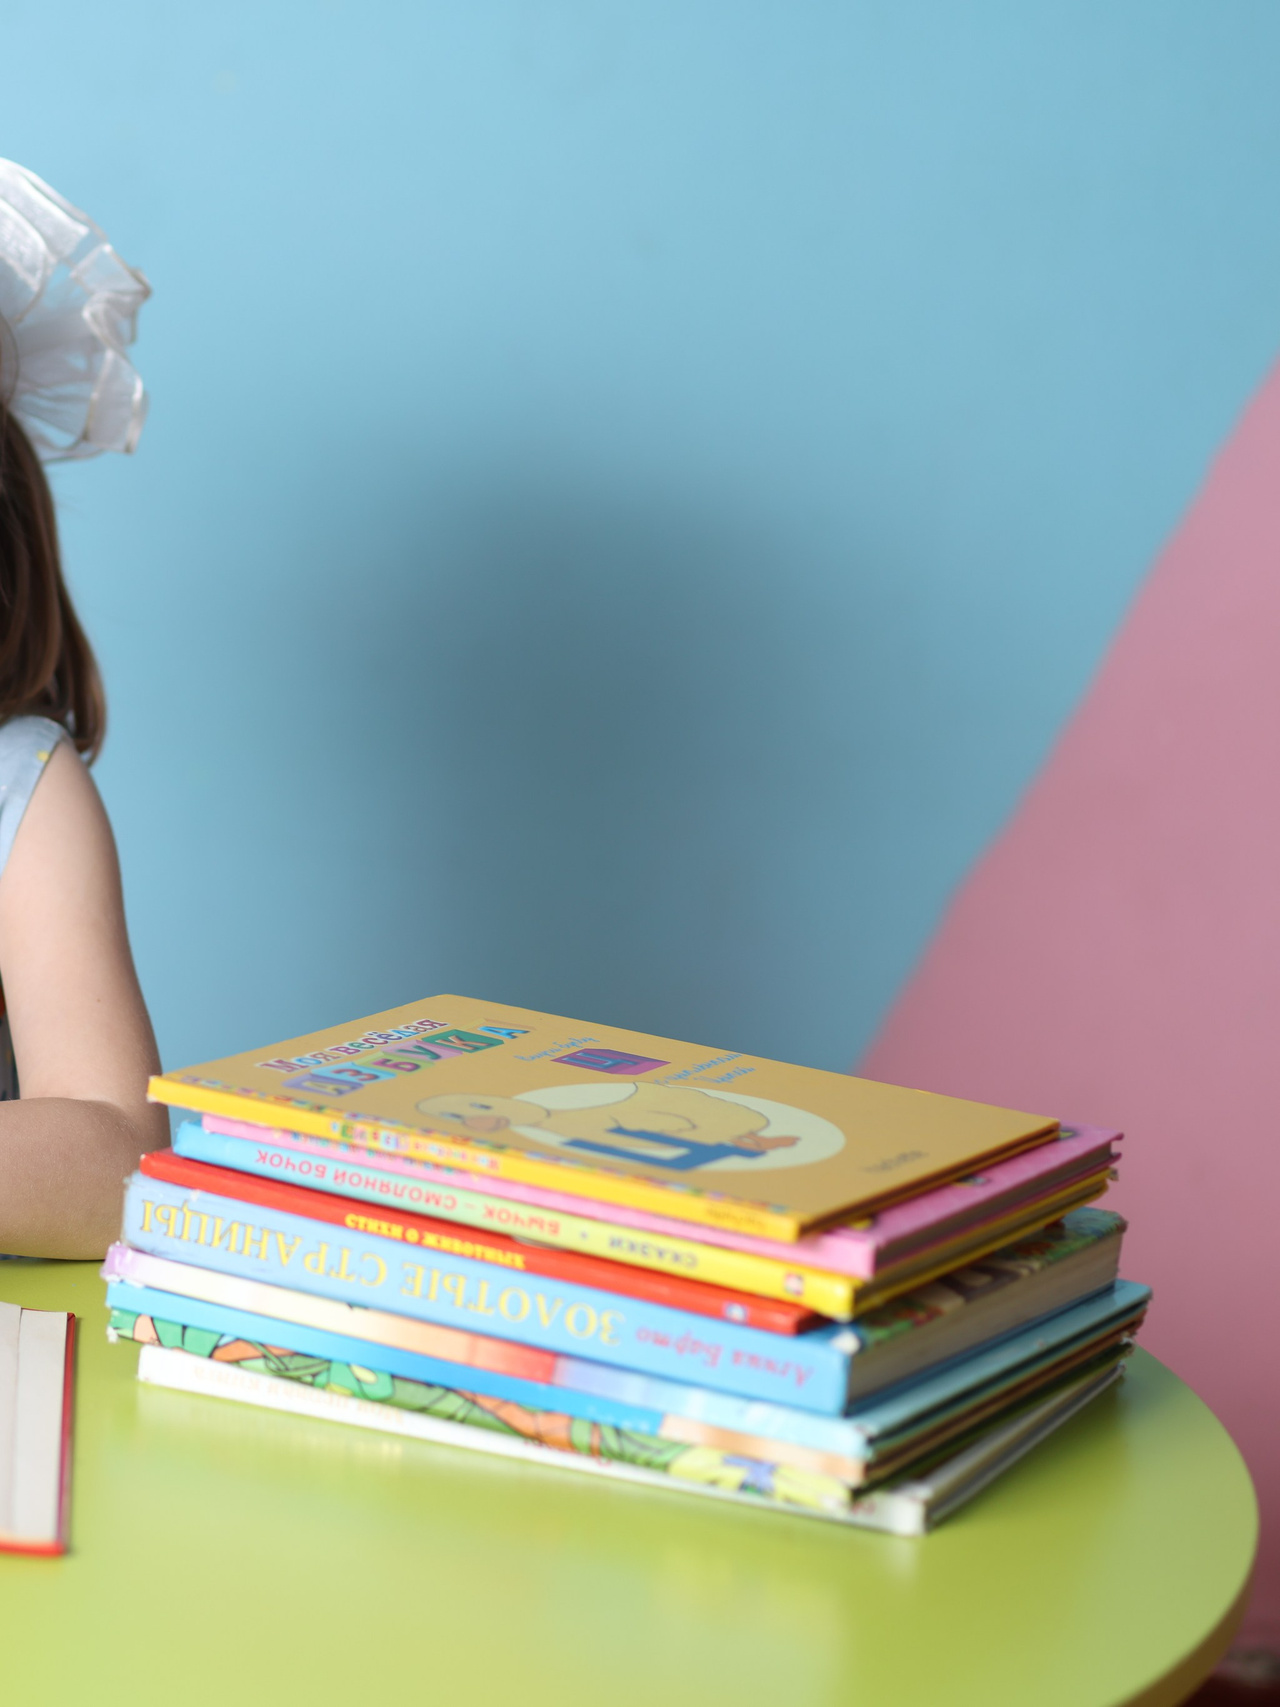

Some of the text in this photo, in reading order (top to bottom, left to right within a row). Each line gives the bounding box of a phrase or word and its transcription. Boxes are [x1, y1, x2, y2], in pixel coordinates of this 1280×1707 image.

[261, 1019, 447, 1073] Моя весёлая
[300, 1025, 530, 1096] АЗБУКА
[255, 1149, 328, 1179] БОЧОК
[333, 1166, 458, 1212] СМОЛЯНОЙ
[345, 1212, 526, 1270] СТИХИ О ЖИВОТНЫХ
[482, 1204, 561, 1236] БЫЧОК
[140, 1199, 626, 1346] ЗОЛОТЫЕ СТРАНИЦЫ
[608, 1234, 700, 1269] СКАЗКИ
[634, 1324, 816, 1388] Агния Барто
